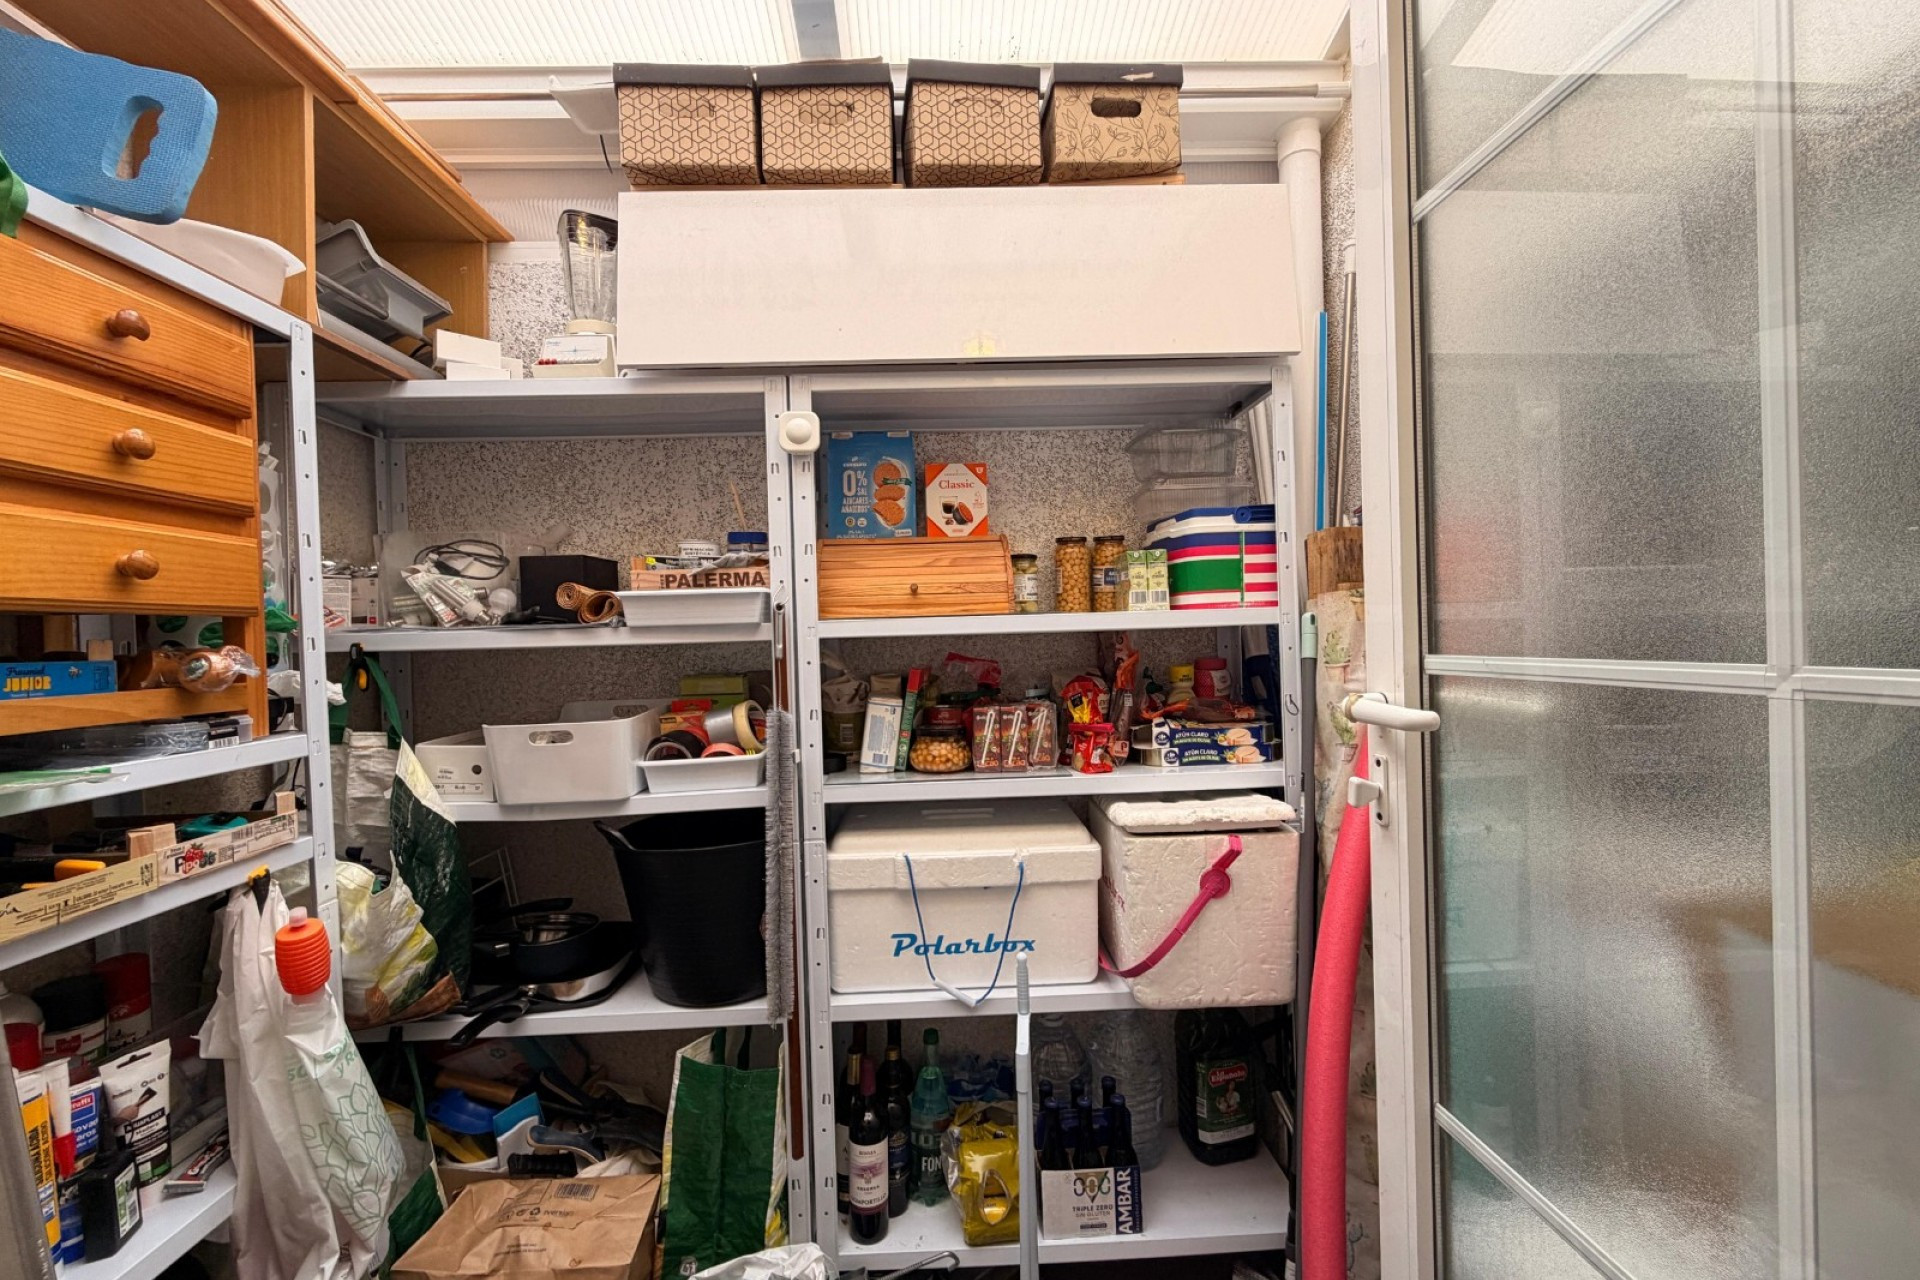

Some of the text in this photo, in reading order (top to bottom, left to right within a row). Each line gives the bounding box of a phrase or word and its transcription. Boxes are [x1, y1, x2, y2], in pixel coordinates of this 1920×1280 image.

[938, 479, 975, 490] Classic
[890, 932, 1036, 957] Polarbox
[1072, 1204, 1094, 1212] TRIPLE
[1116, 1167, 1134, 1234] AMBAR
